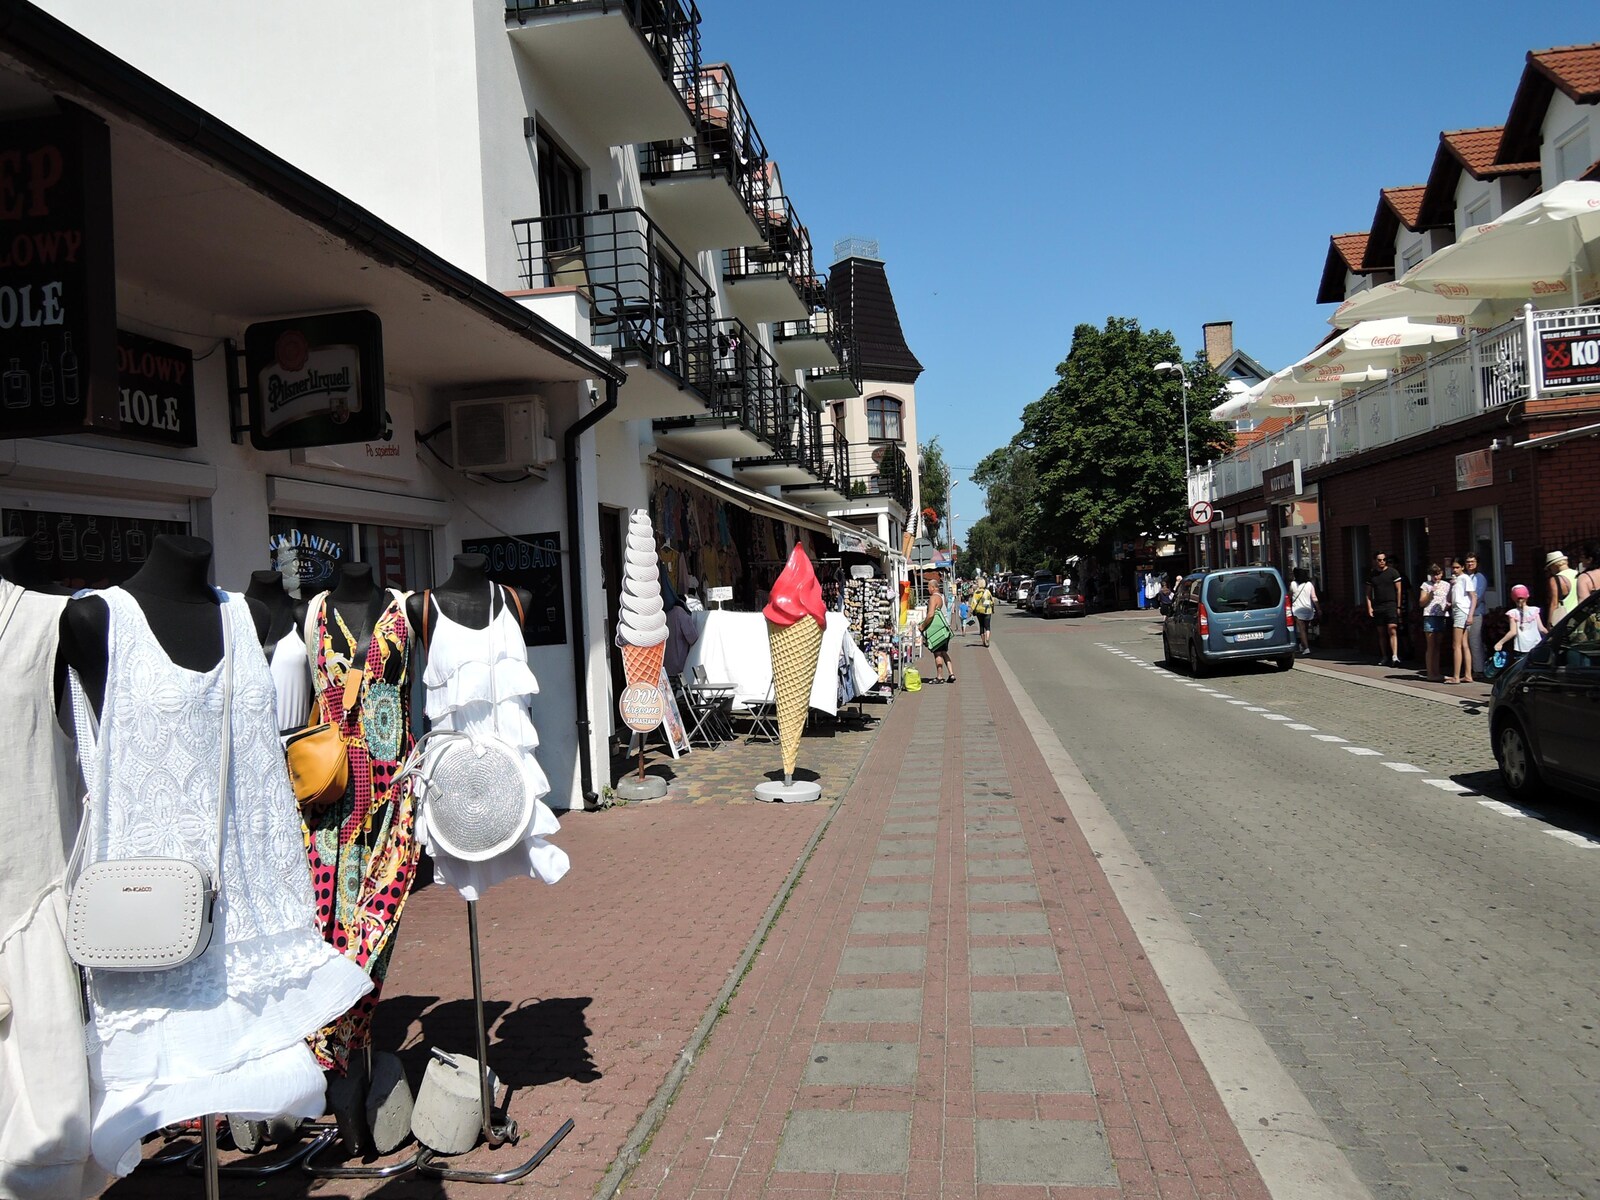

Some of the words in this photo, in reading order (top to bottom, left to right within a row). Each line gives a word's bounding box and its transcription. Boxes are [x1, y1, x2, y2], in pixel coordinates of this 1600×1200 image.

[1571, 340, 1600, 365] KO
[268, 374, 309, 412] Pilsner
[308, 367, 349, 395] Urquell
